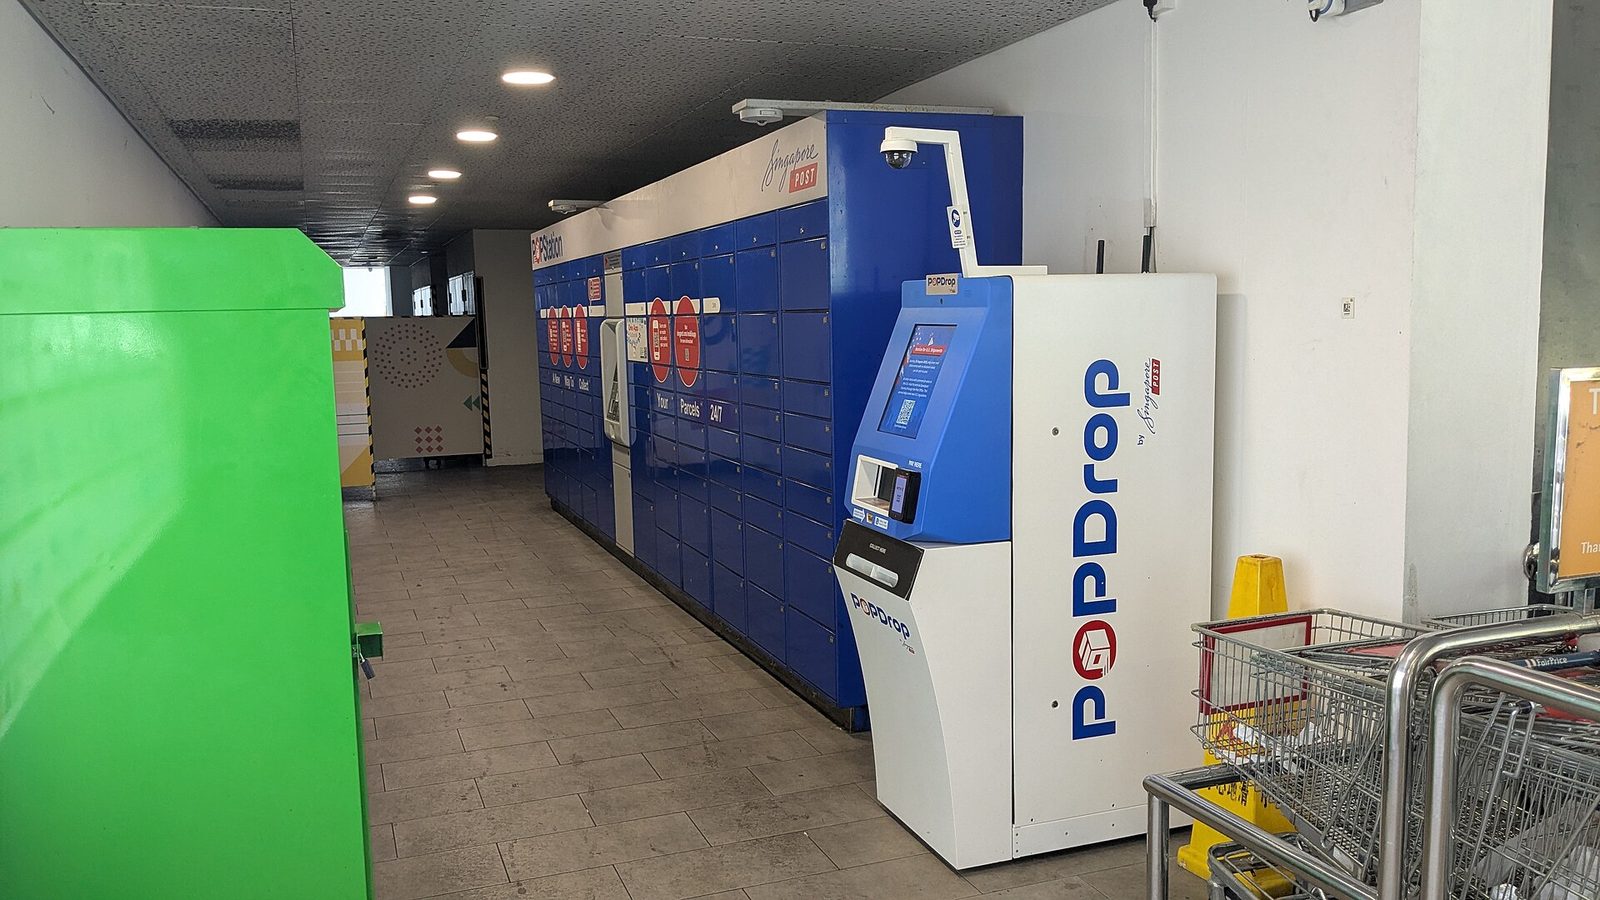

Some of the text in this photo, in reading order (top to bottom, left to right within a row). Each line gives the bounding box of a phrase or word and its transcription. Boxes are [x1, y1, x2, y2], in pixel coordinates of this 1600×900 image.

[761, 139, 819, 192] Singapore
[795, 168, 816, 188] POST
[927, 277, 956, 287] POPDrop
[1152, 362, 1160, 388] POST
[656, 392, 723, 423] Your Parcels 24/7
[1137, 357, 1159, 434] Singapore
[1137, 434, 1145, 445] by
[1072, 359, 1131, 741] POPDrop
[1580, 541, 1600, 555] Tha
[850, 592, 911, 640] POPDrop
[1536, 656, 1569, 667] FairPrice
